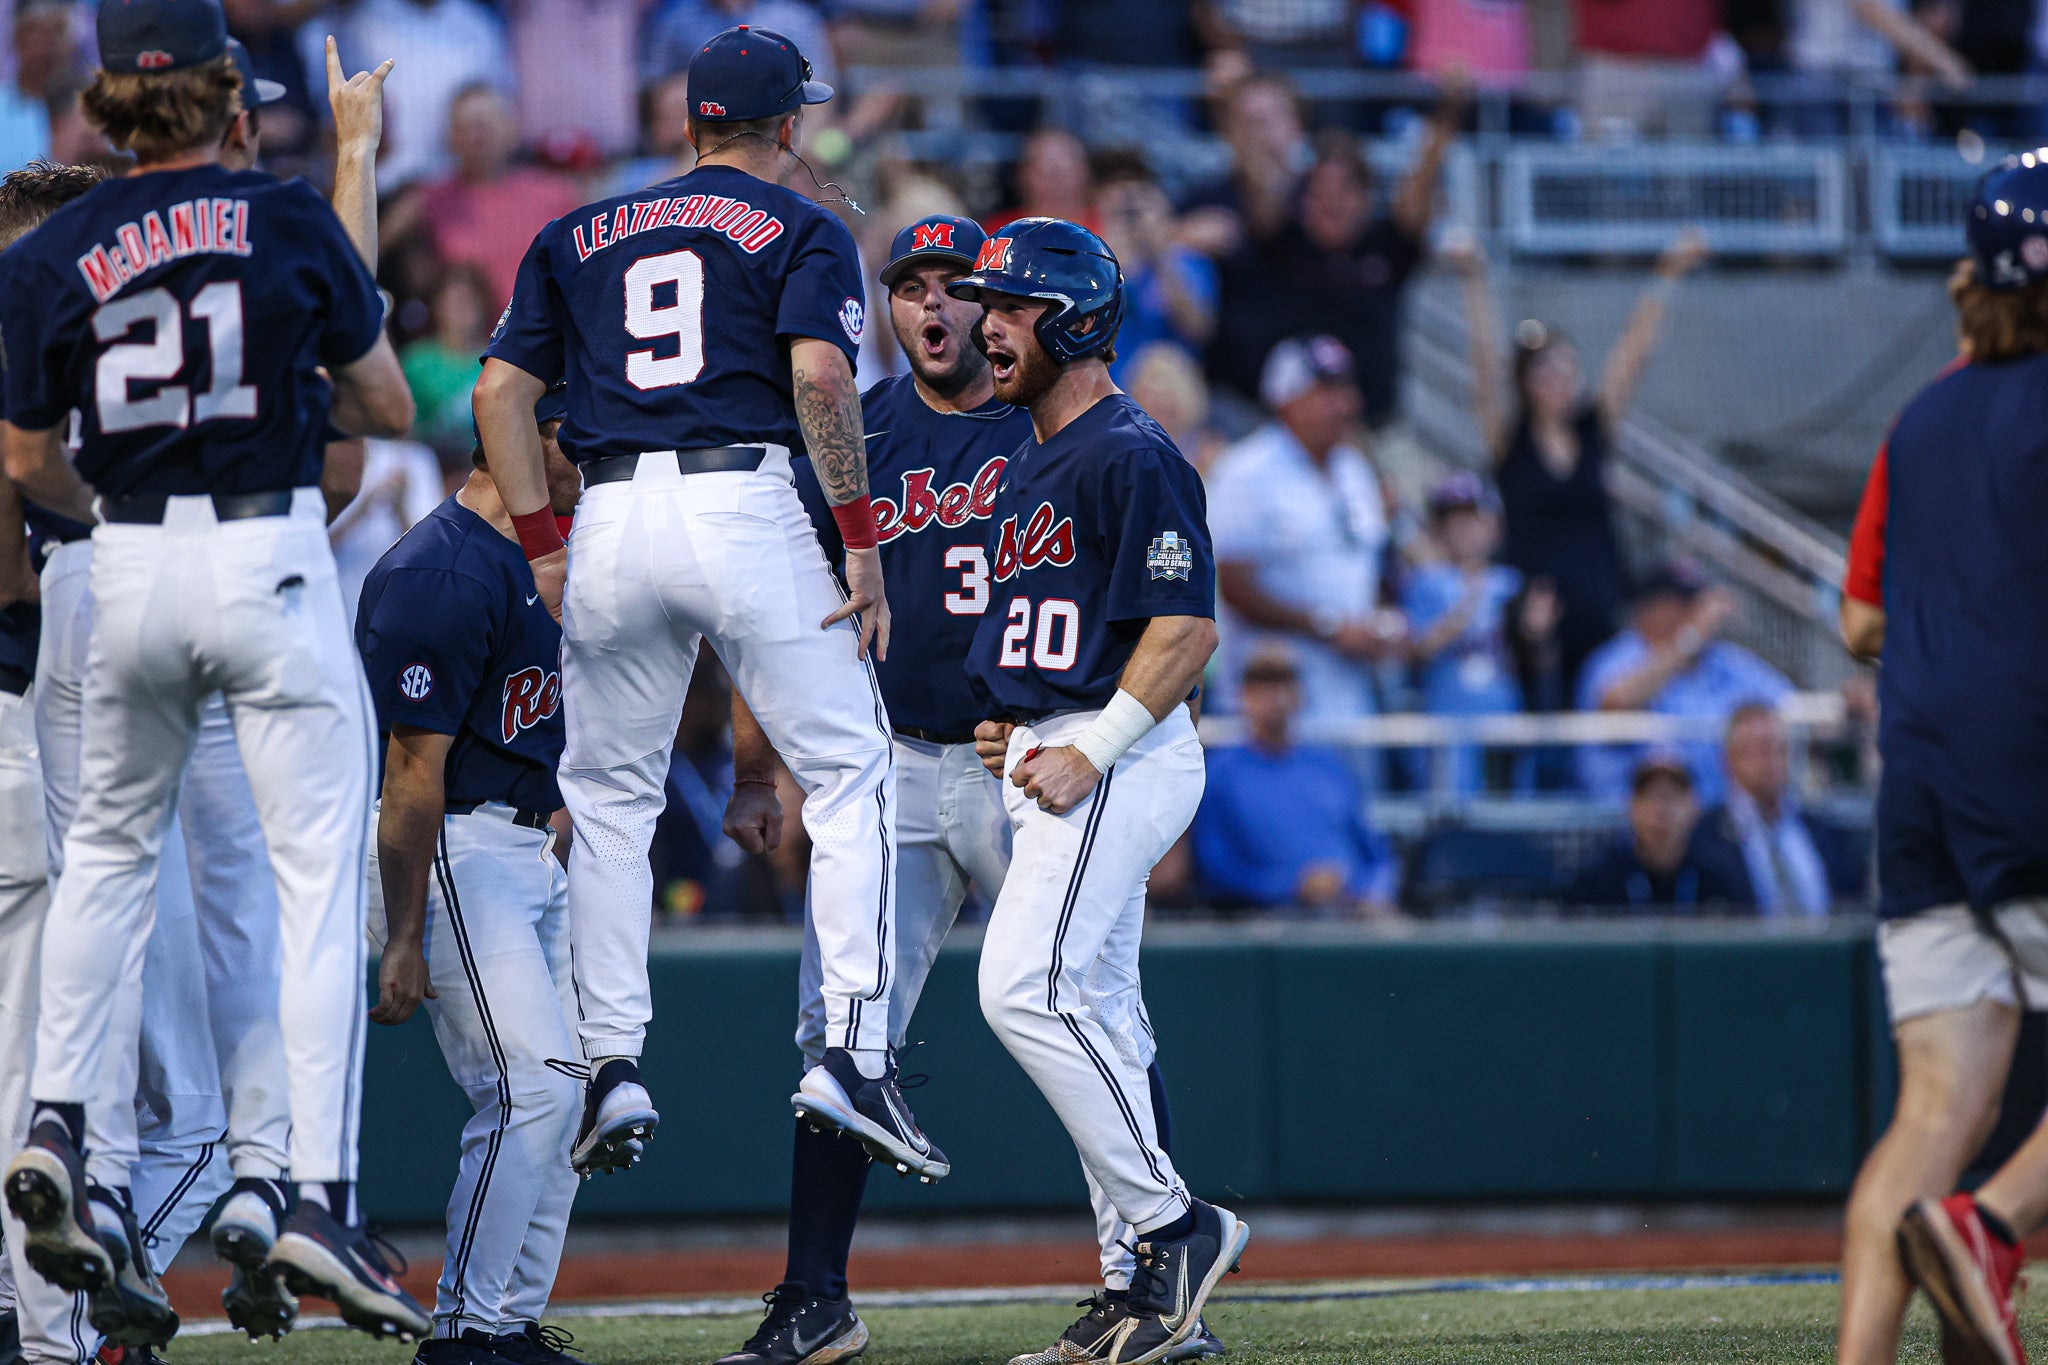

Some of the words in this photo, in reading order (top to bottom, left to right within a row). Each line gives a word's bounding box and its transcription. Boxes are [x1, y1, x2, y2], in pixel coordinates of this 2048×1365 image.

[77, 198, 252, 303] McDANIEL
[573, 195, 784, 263] LEATHERWOOD
[911, 223, 955, 251] M
[973, 237, 1014, 272] M
[622, 248, 706, 392] 9
[845, 299, 863, 332] SEC
[90, 279, 257, 434] 21
[870, 456, 1008, 544] ebel
[1149, 560, 1170, 568] WORLD
[1170, 560, 1191, 568] SERIES
[1157, 553, 1183, 561] COLLEGE
[998, 596, 1080, 672] 20
[401, 665, 431, 699] SEC
[502, 658, 562, 744] Re
